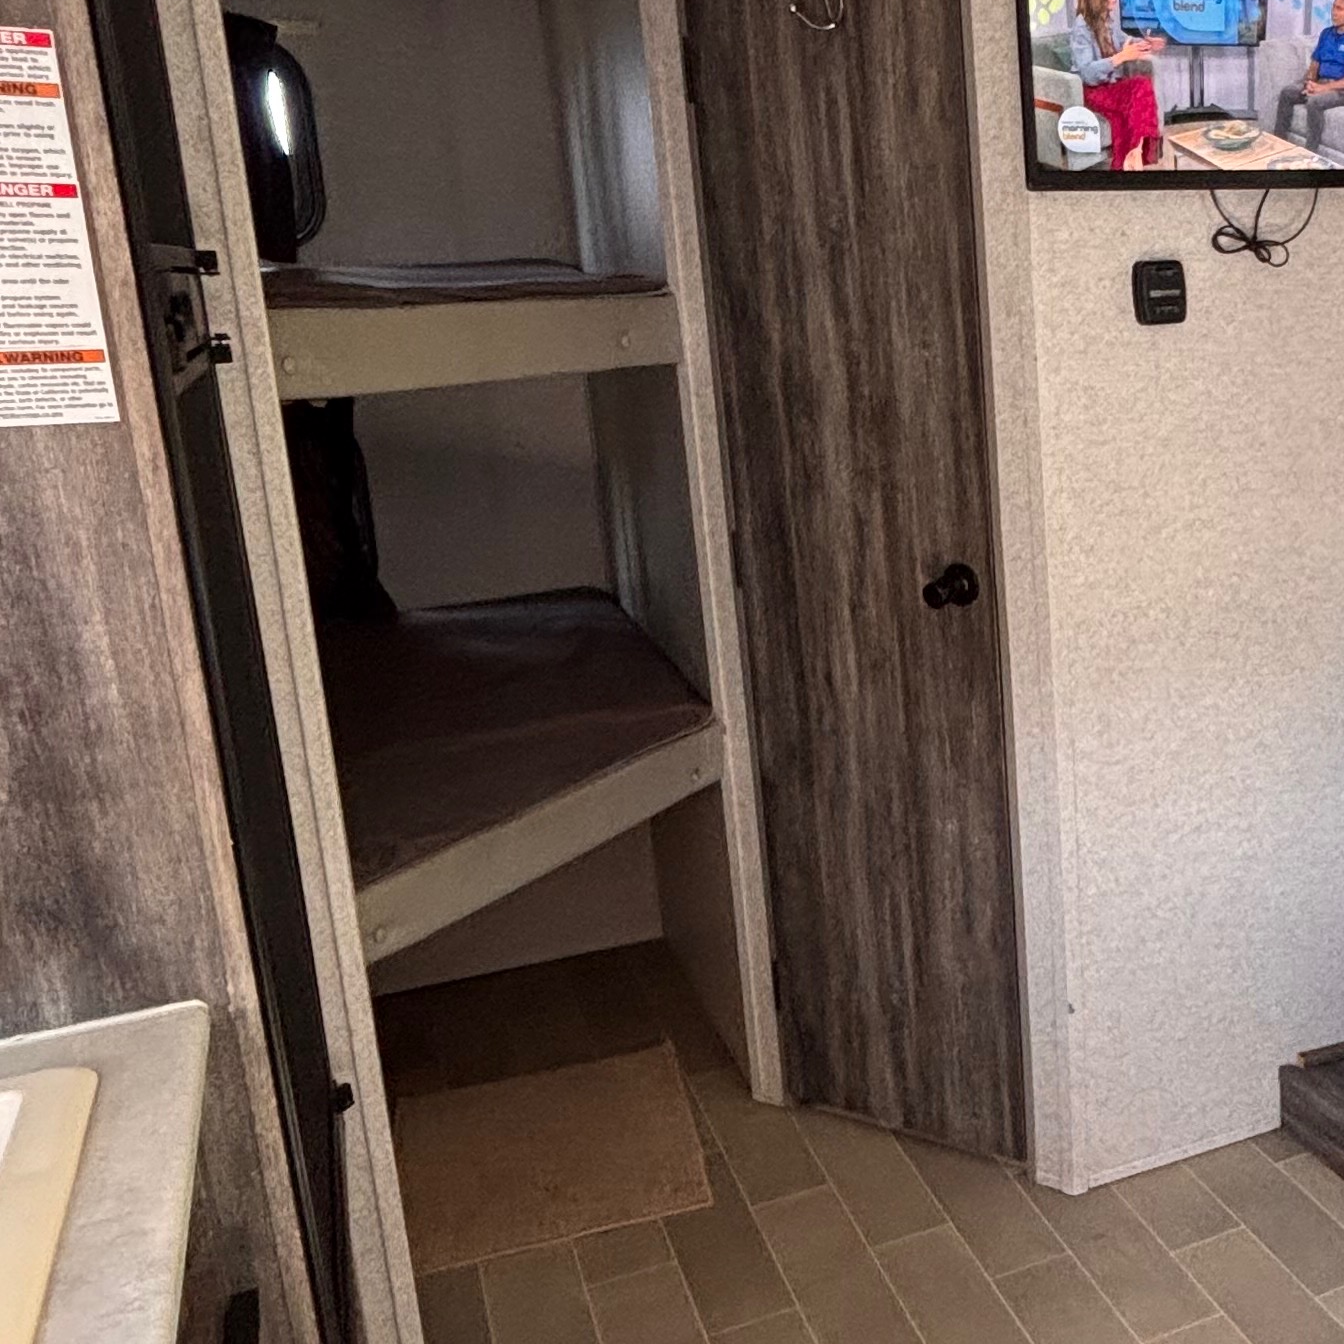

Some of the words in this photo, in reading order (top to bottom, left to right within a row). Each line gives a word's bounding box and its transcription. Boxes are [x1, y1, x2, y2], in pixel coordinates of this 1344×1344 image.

[1173, 0, 1206, 13] blend
[1062, 125, 1098, 135] morning
[0, 183, 54, 197] NGER
[4, 350, 83, 363] WARNING
